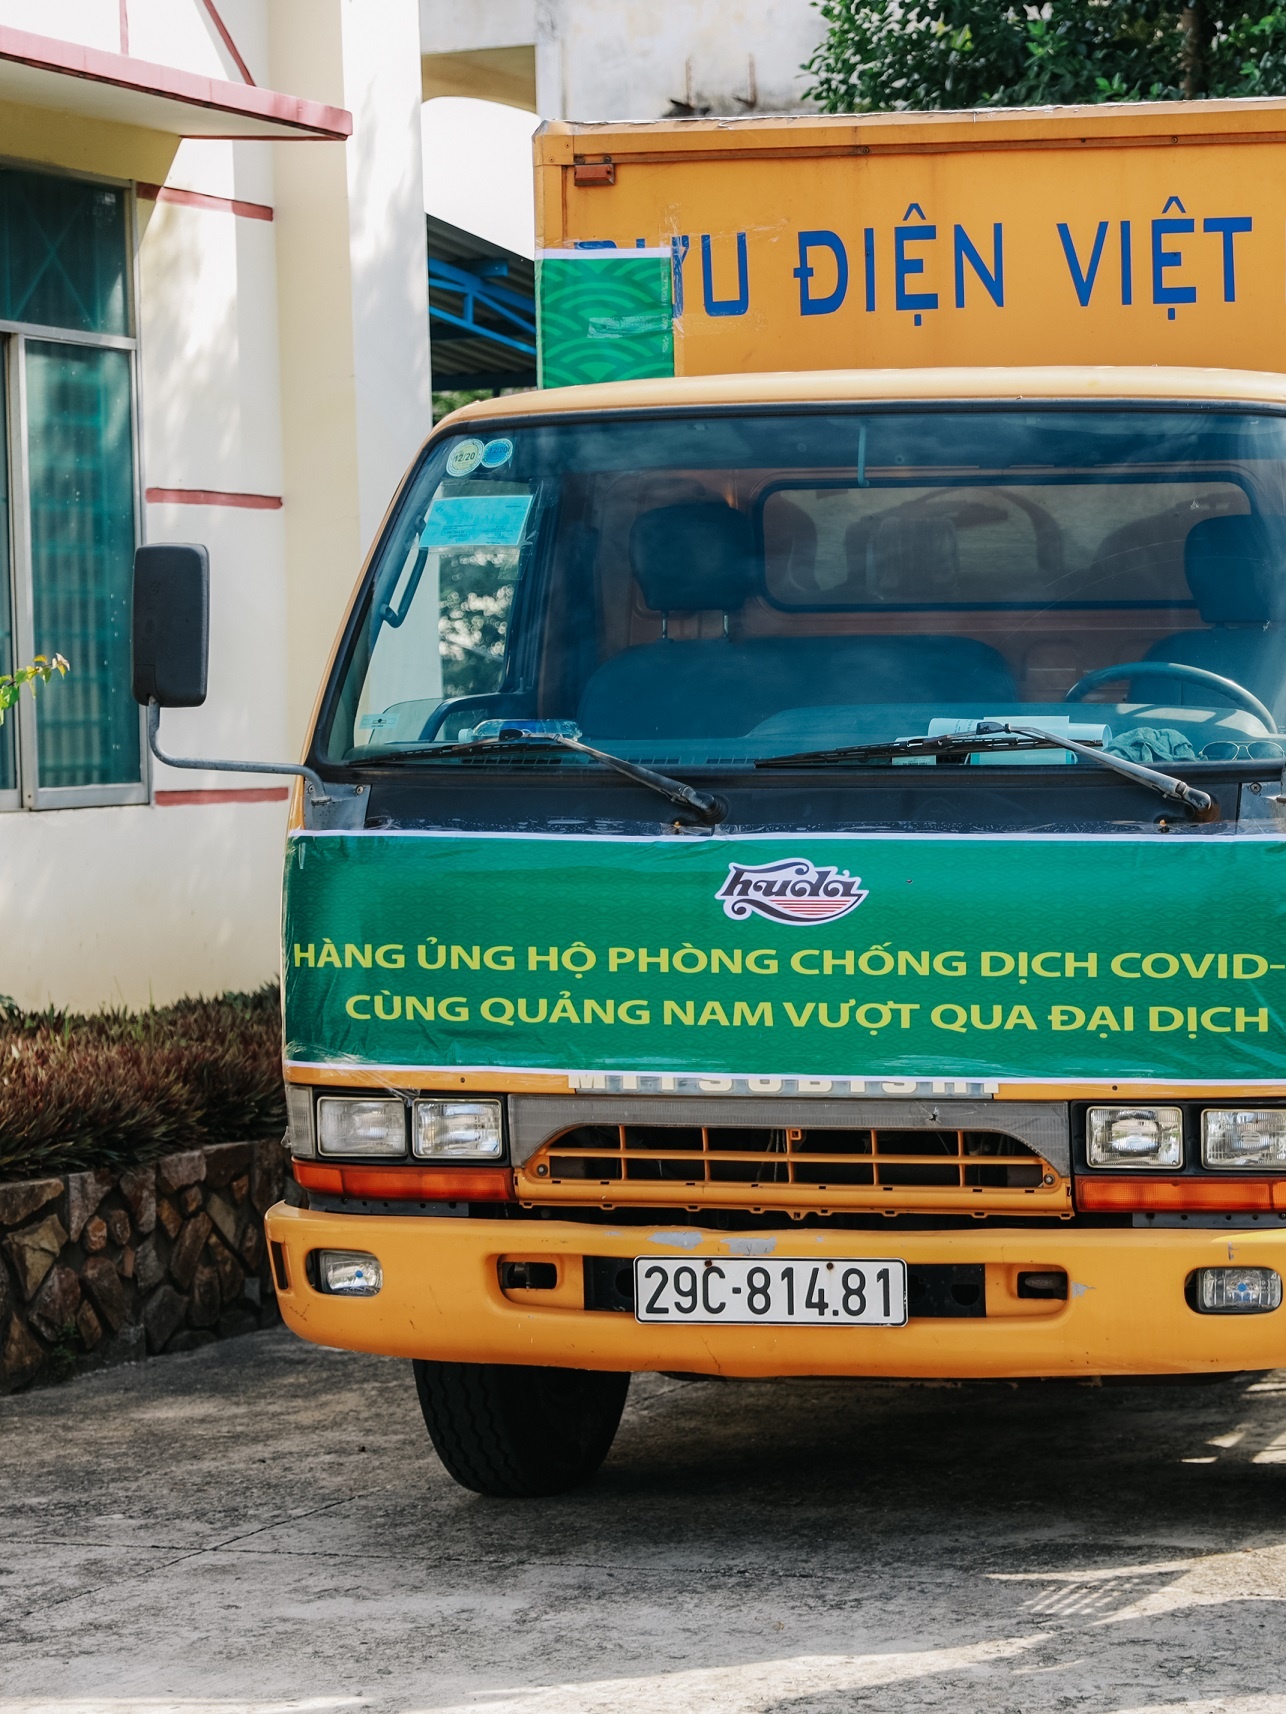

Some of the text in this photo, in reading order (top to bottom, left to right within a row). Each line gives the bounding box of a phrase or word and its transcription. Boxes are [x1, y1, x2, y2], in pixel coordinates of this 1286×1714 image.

[793, 202, 1005, 327] ĐIỆN
[1055, 195, 1254, 321] VIỆT
[455, 452, 476, 463] 12/20
[719, 862, 866, 898] huda
[293, 938, 405, 969] HÀNG
[416, 937, 514, 971] ỦNG
[528, 941, 597, 979] HỘ
[608, 942, 779, 975] PHÒNG
[790, 942, 967, 977] CHỐNG
[981, 950, 1098, 985] DỊCH
[345, 990, 1269, 1040] CÙNG QUẢNG NAM VƯỢT QUA ĐẠI DỊCH
[644, 1265, 890, 1317] 29C-814.81
